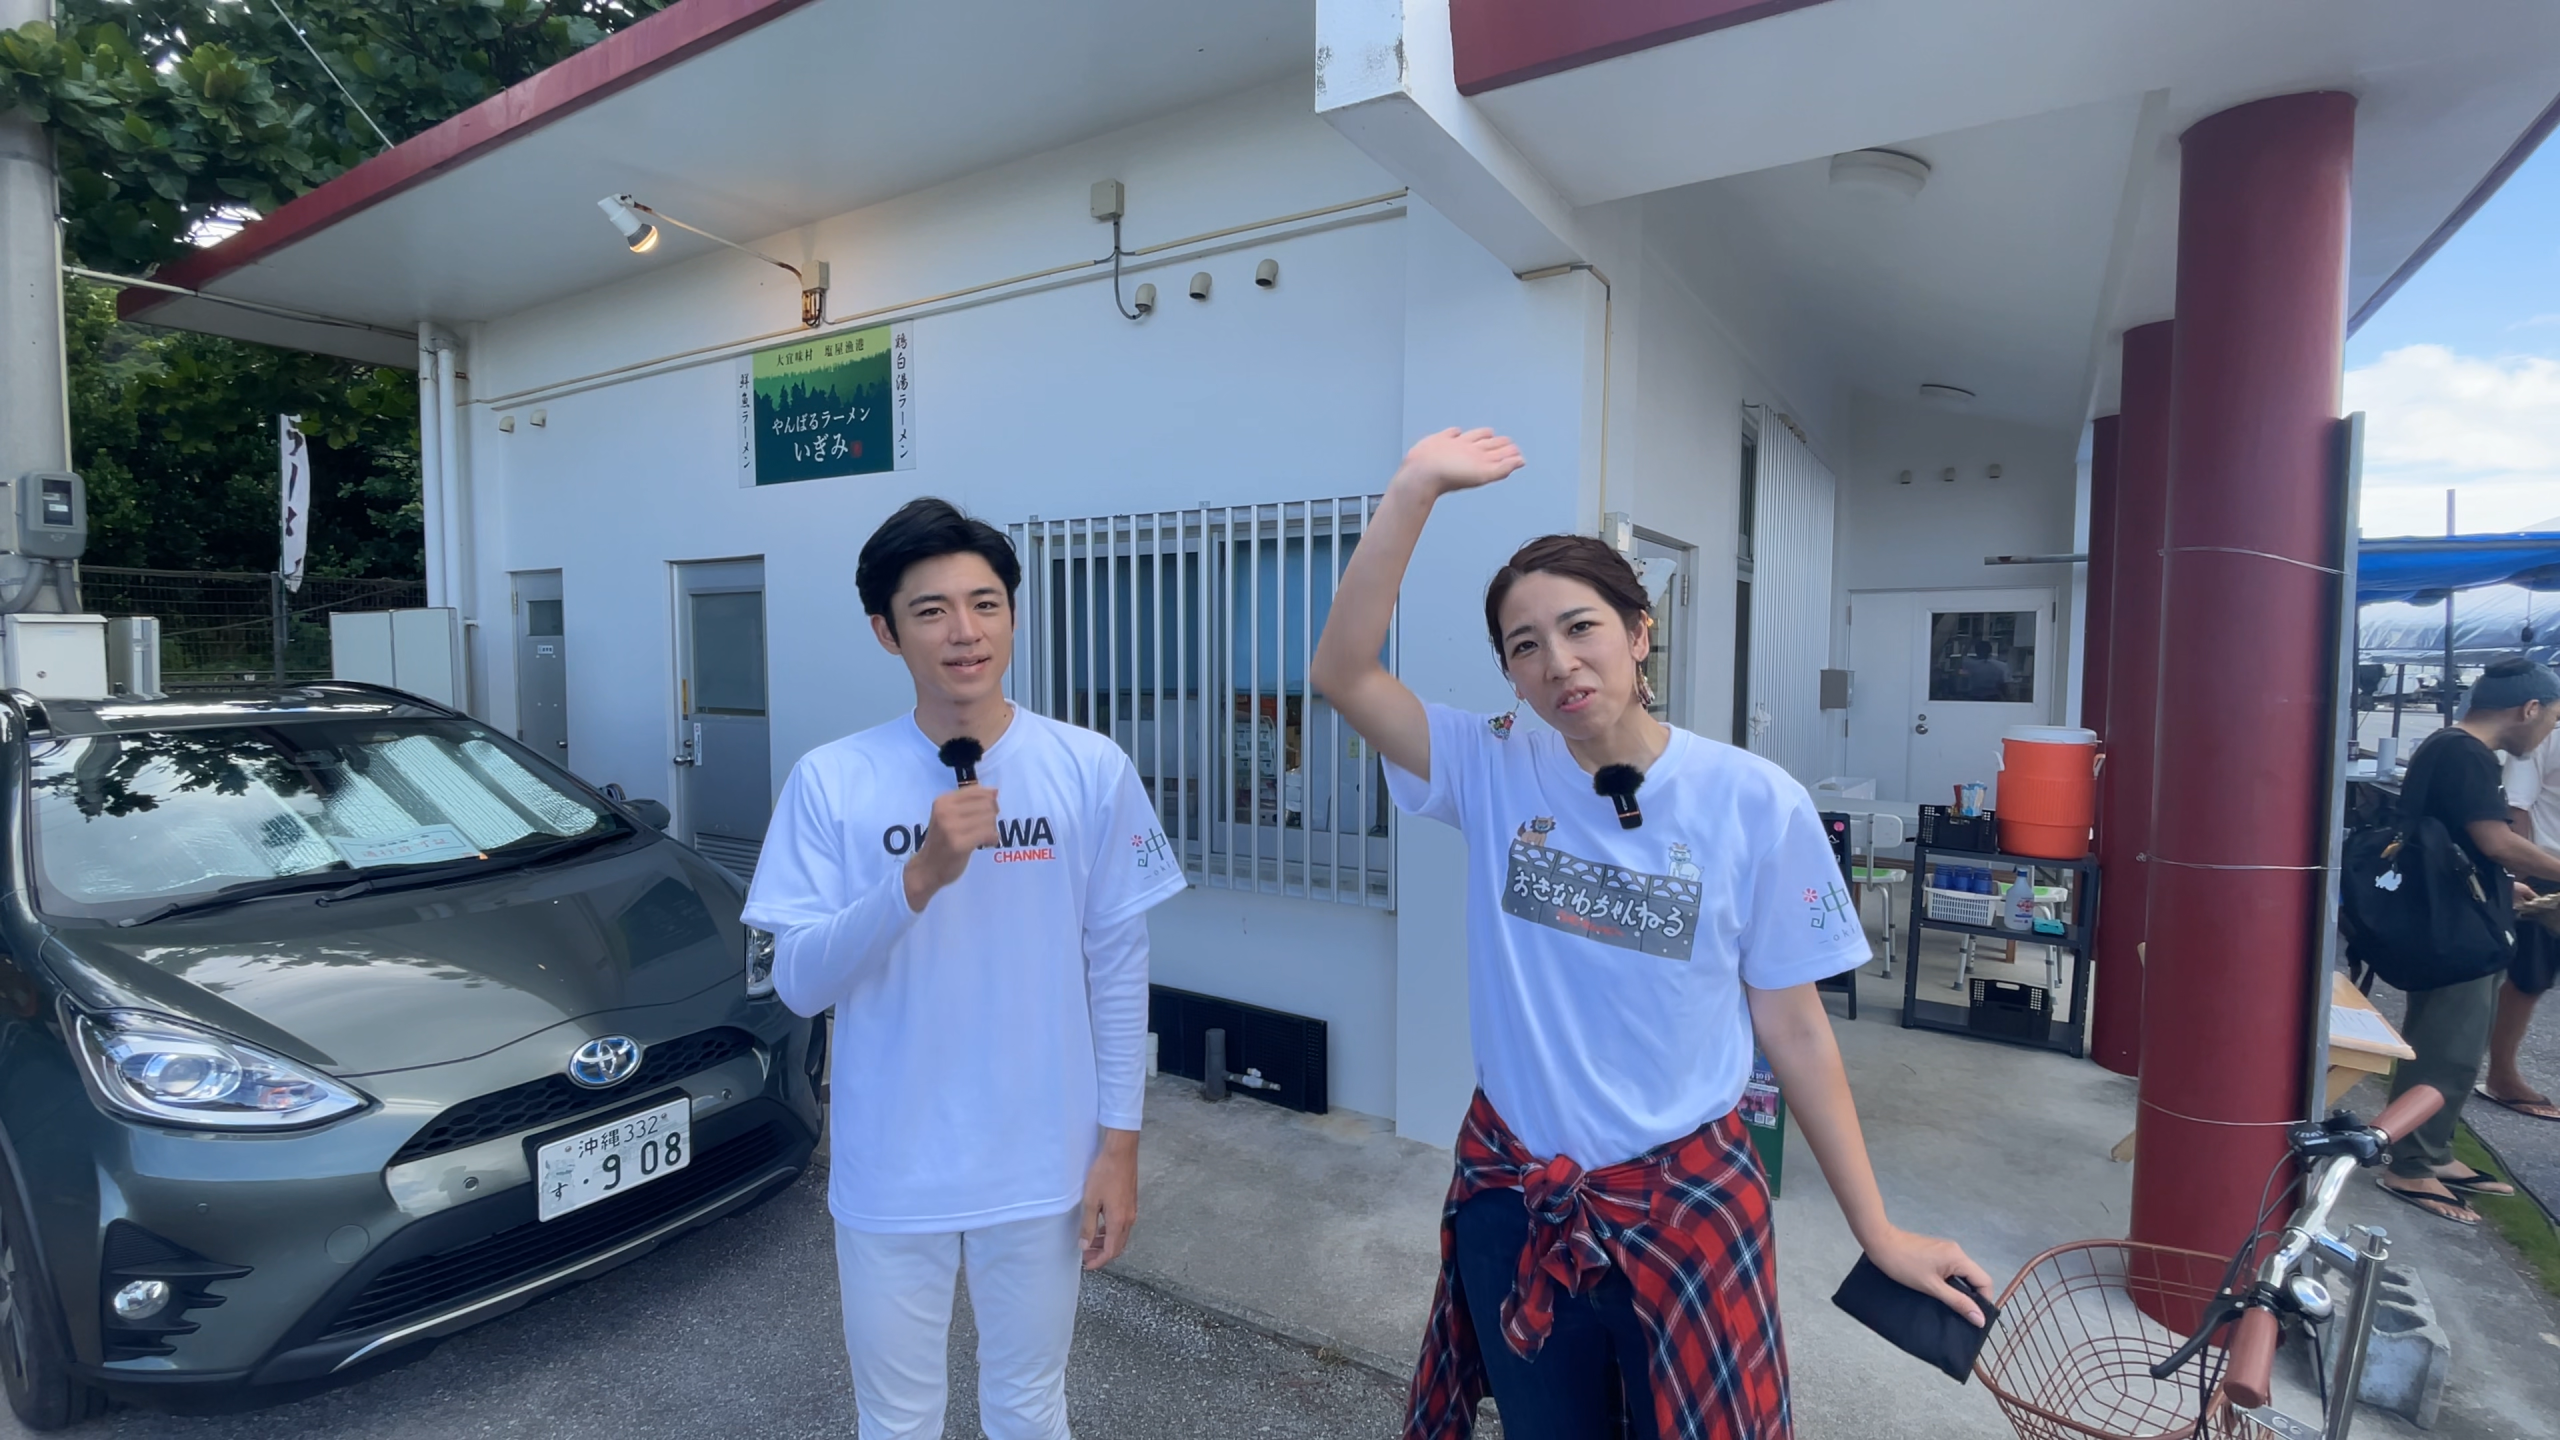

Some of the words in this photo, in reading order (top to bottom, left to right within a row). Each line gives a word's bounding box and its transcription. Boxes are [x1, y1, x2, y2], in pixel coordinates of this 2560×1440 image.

[776, 349, 813, 367] 大宜味村
[824, 338, 864, 358] 塩屋漁港
[894, 334, 909, 459] 鶏白湯ラーメン
[739, 373, 751, 469] 鮮魚ラーメン
[772, 407, 871, 436] やんばるラーメン
[794, 433, 849, 462] いぎみ
[994, 849, 1056, 863] CHANNEL
[1512, 870, 1685, 938] おきなわちゃんねる
[551, 1182, 568, 1201] す
